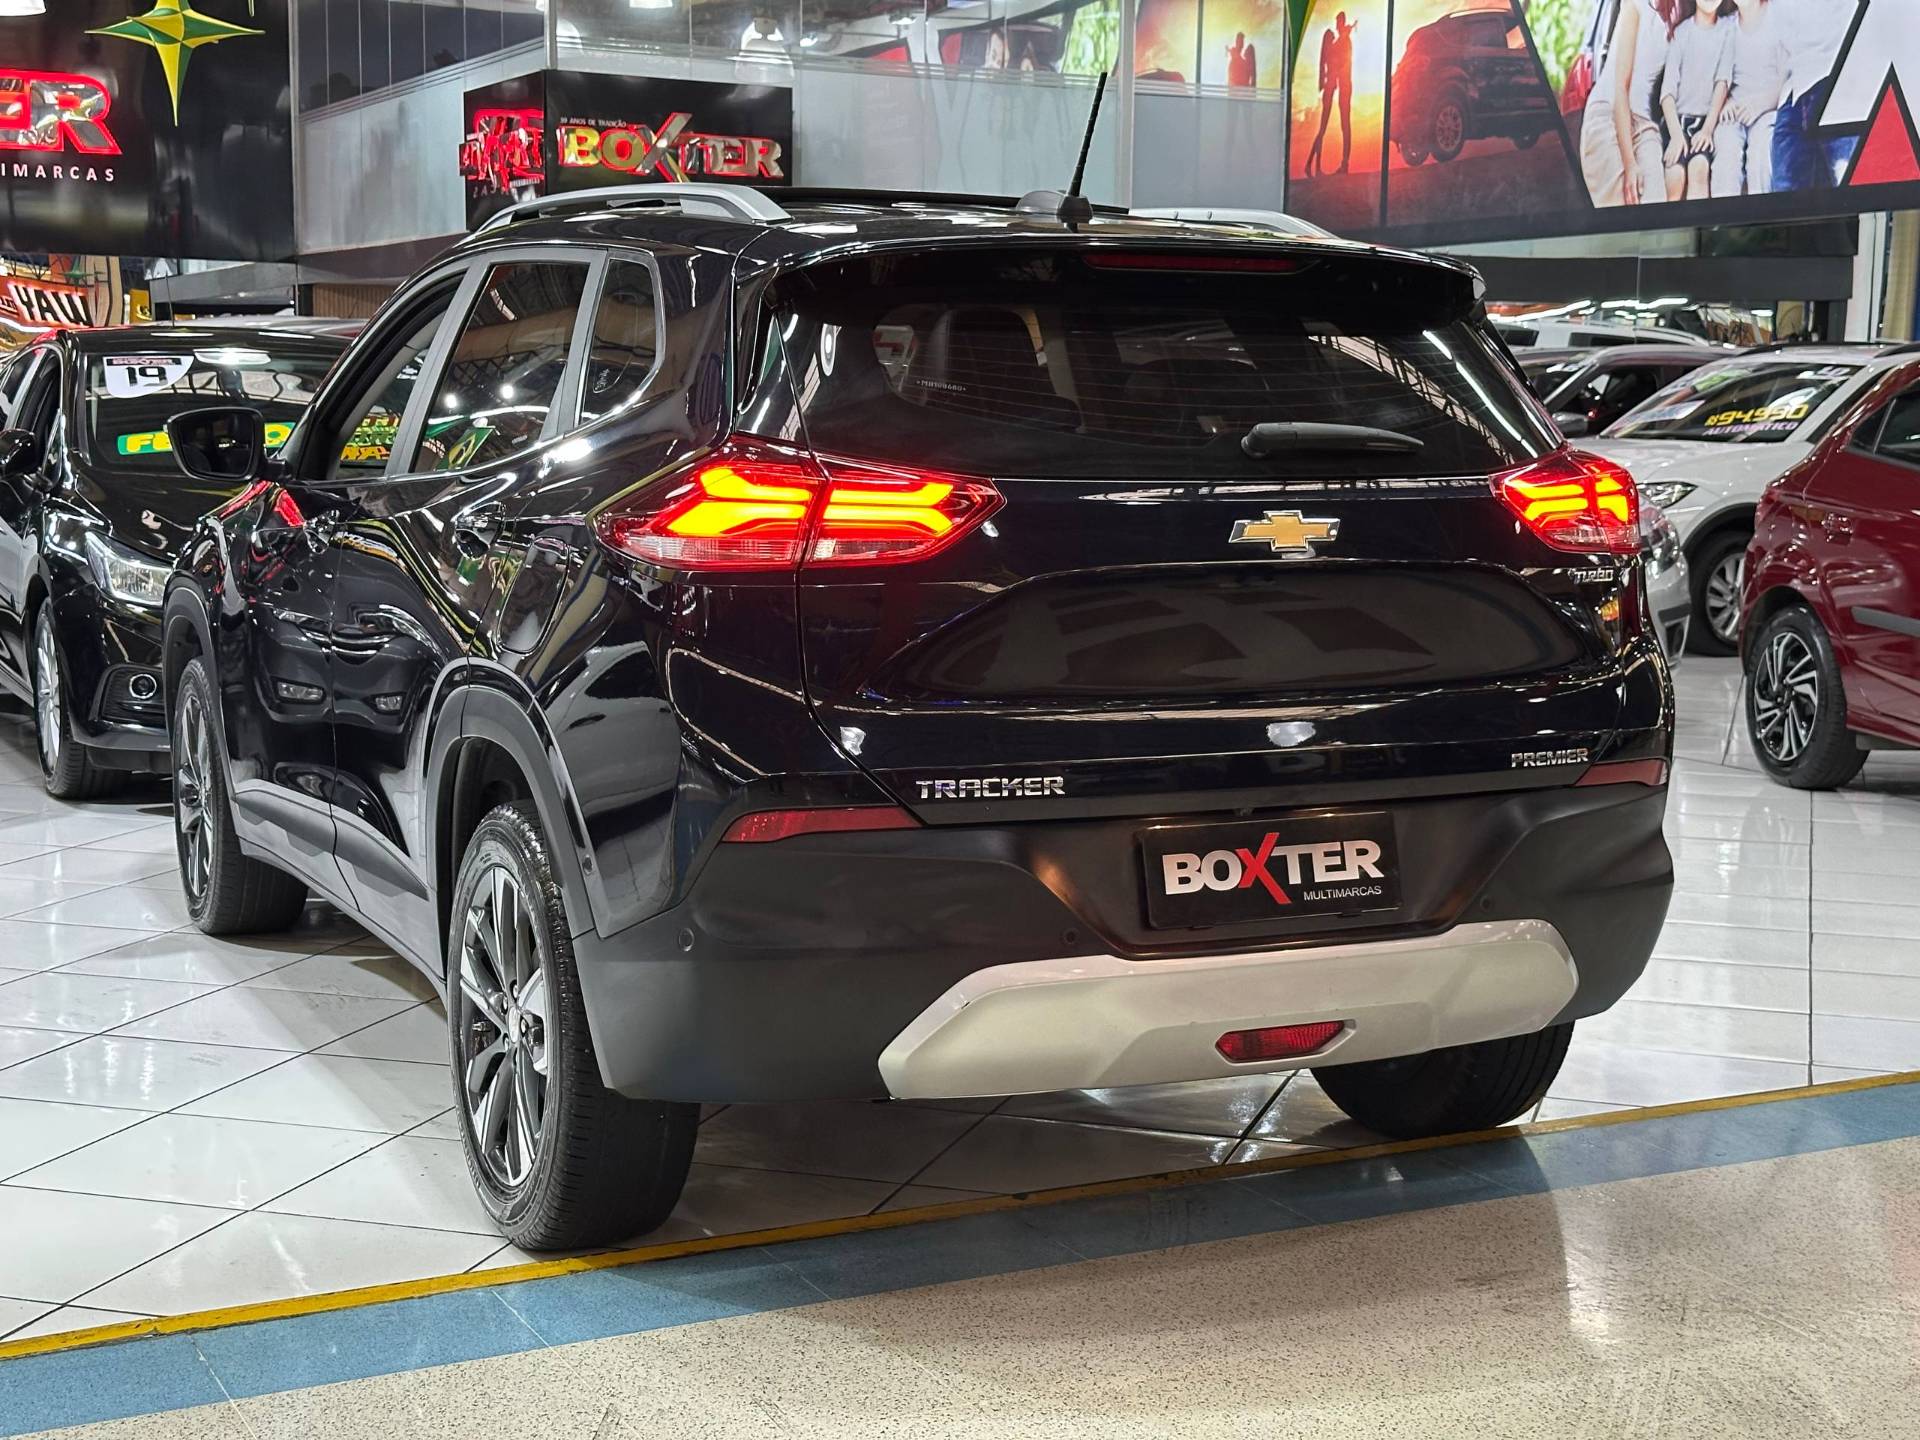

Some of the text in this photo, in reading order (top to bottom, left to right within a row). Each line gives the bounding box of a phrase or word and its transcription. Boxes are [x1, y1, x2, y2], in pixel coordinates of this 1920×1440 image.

[556, 112, 784, 183] BOXTER
[126, 366, 168, 387] 19
[1511, 747, 1589, 768] PREMIER
[915, 776, 1066, 799] TRACKER
[1162, 832, 1385, 904] BOXTER
[1303, 885, 1382, 901] MULTIMARCAS
